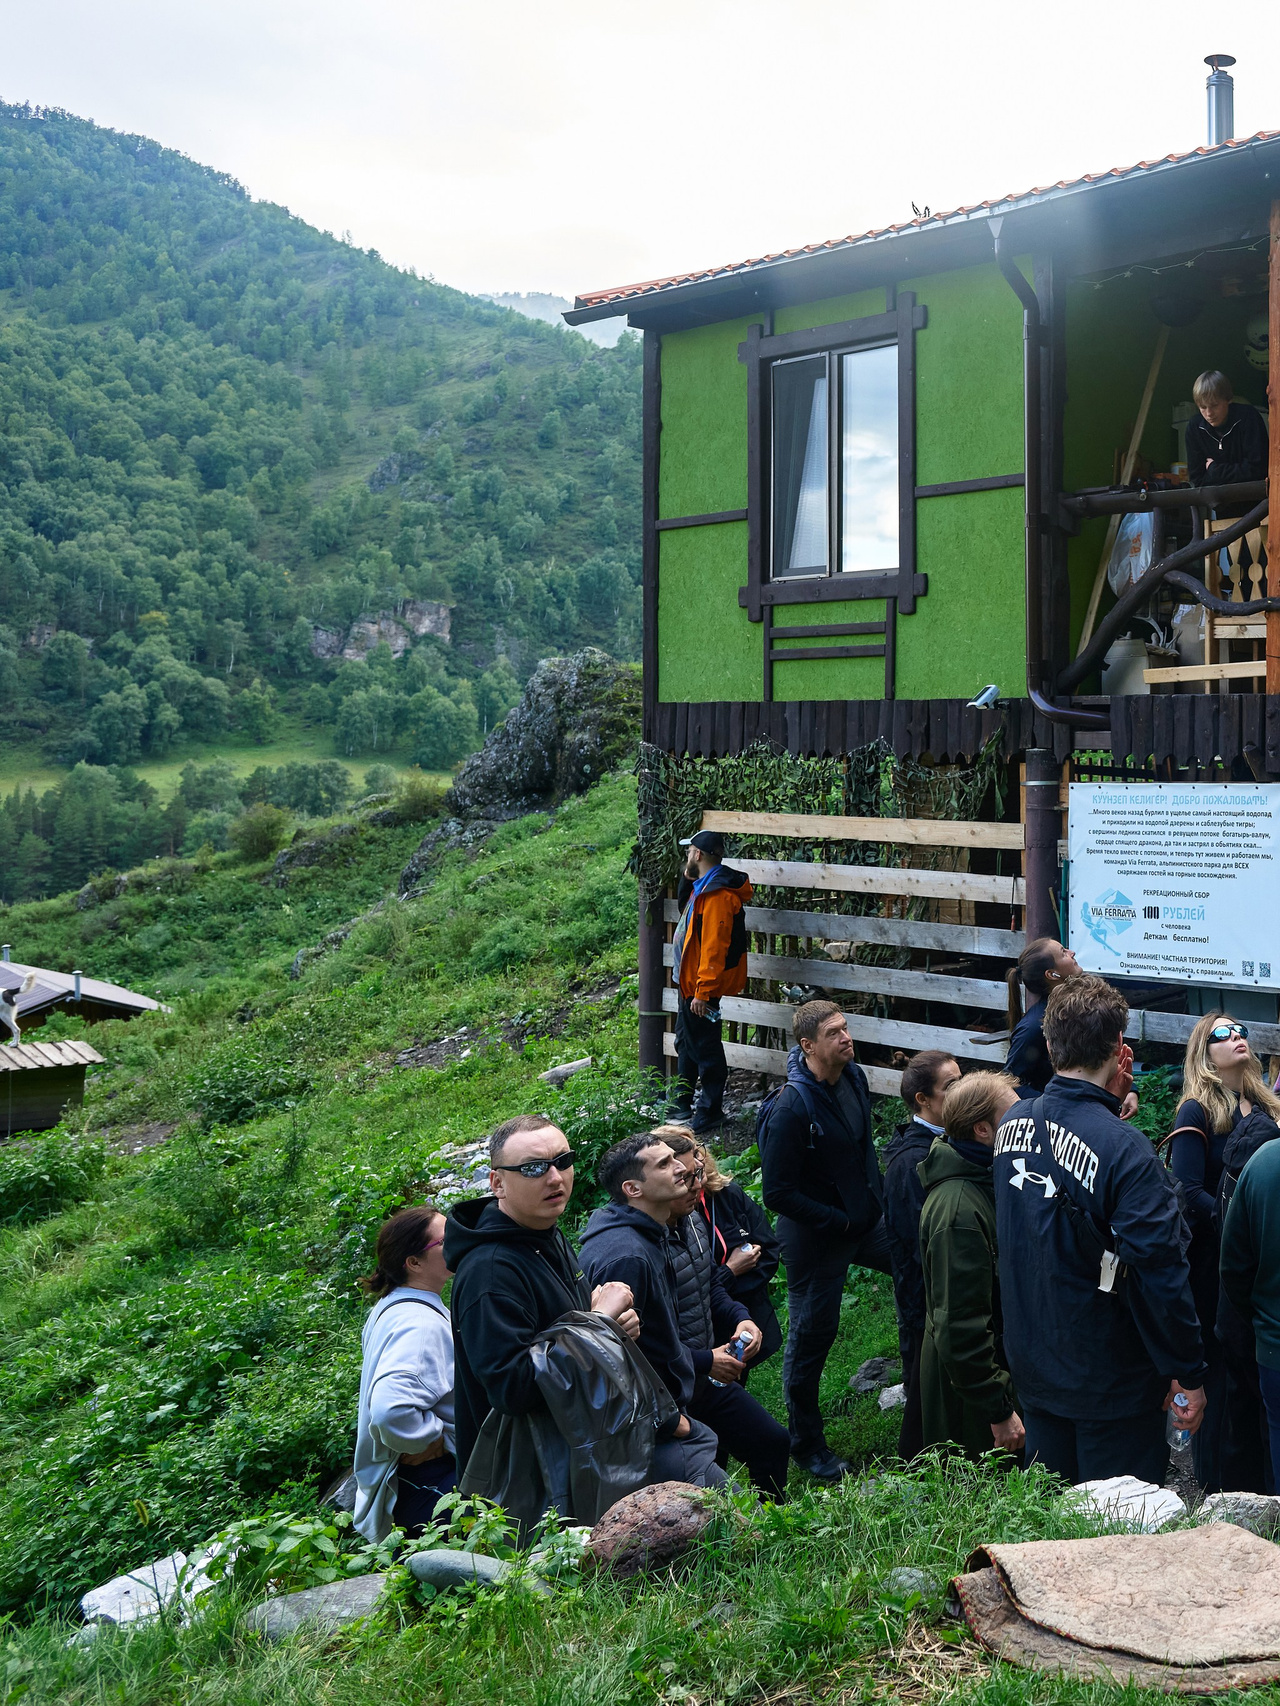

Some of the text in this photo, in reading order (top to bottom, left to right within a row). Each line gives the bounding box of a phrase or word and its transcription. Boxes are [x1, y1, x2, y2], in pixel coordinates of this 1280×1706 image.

[1172, 795, 1200, 805] ДОБРО
[1203, 795, 1268, 805] ПОЖАЛОВАТЬ!
[1222, 831, 1270, 839] богатырь-валун,
[1143, 889, 1210, 899] РЕКРЕАЦИОННЫЙ СБОР
[1091, 907, 1136, 919] VIA FERRATA
[1142, 905, 1205, 920] 100 РУБЛЕЙ
[1144, 932, 1209, 943] Деткам бесплатно!
[1127, 952, 1228, 965] ВНИМАНИЕ! ЧАСТНАЯ ТЕРРИТОРИЯ!
[1120, 962, 1159, 971] Ознакомьтесь,
[1161, 965, 1195, 974] пожалуйста,
